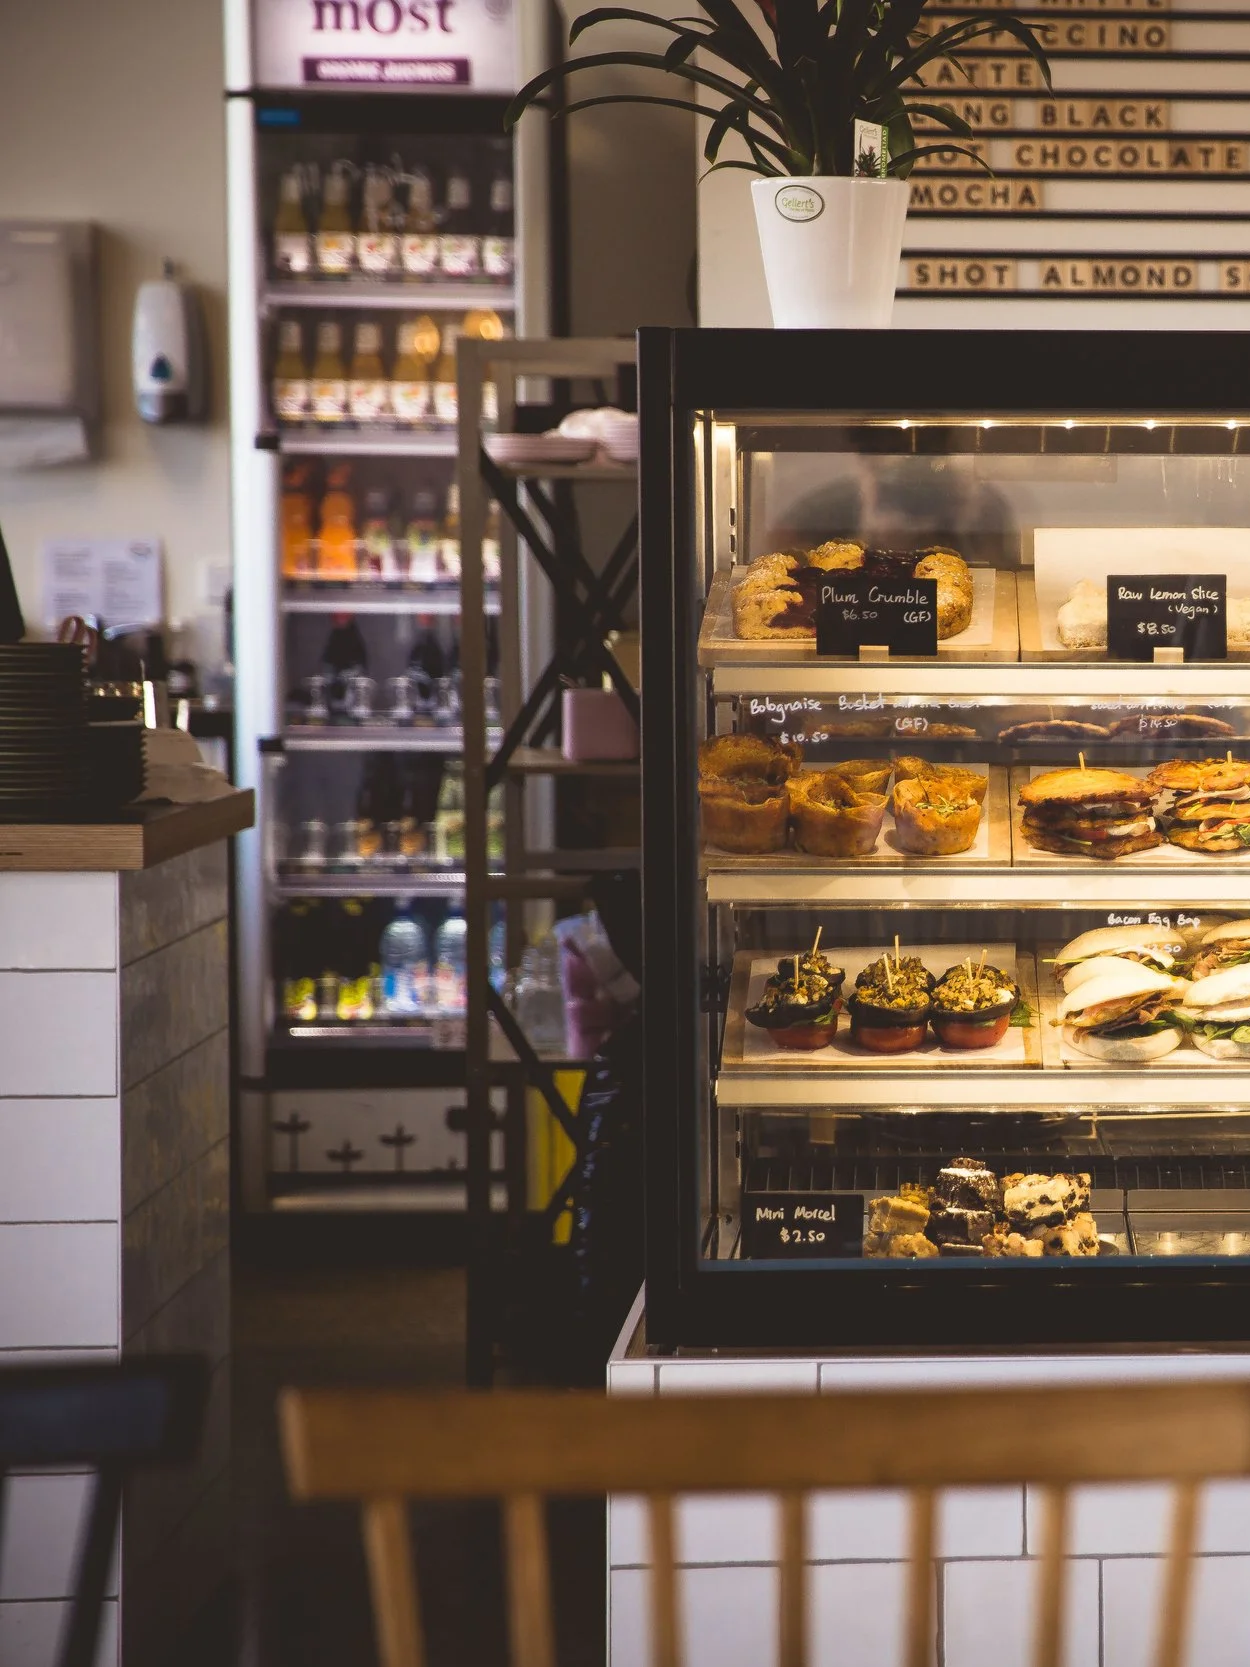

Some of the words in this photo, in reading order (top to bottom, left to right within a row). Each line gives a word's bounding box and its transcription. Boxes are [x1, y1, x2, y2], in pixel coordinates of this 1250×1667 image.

[916, 62, 1033, 86] ATTE
[1041, 103, 1164, 128] BLACK
[1015, 145, 1243, 171] CHOCOLATE
[909, 184, 1037, 206] MOCHA
[915, 263, 1009, 285] SHOT
[1043, 264, 1193, 287] ALMOND
[821, 585, 859, 605] Plum
[868, 585, 930, 605] Crumble
[1118, 586, 1143, 600] Raw
[1149, 587, 1187, 600] Lemon
[841, 608, 879, 620] $6.50
[903, 610, 932, 623] (GF)
[1137, 621, 1177, 635] $8.50
[756, 1206, 785, 1221] Mini
[780, 1226, 826, 1243] $2.50
